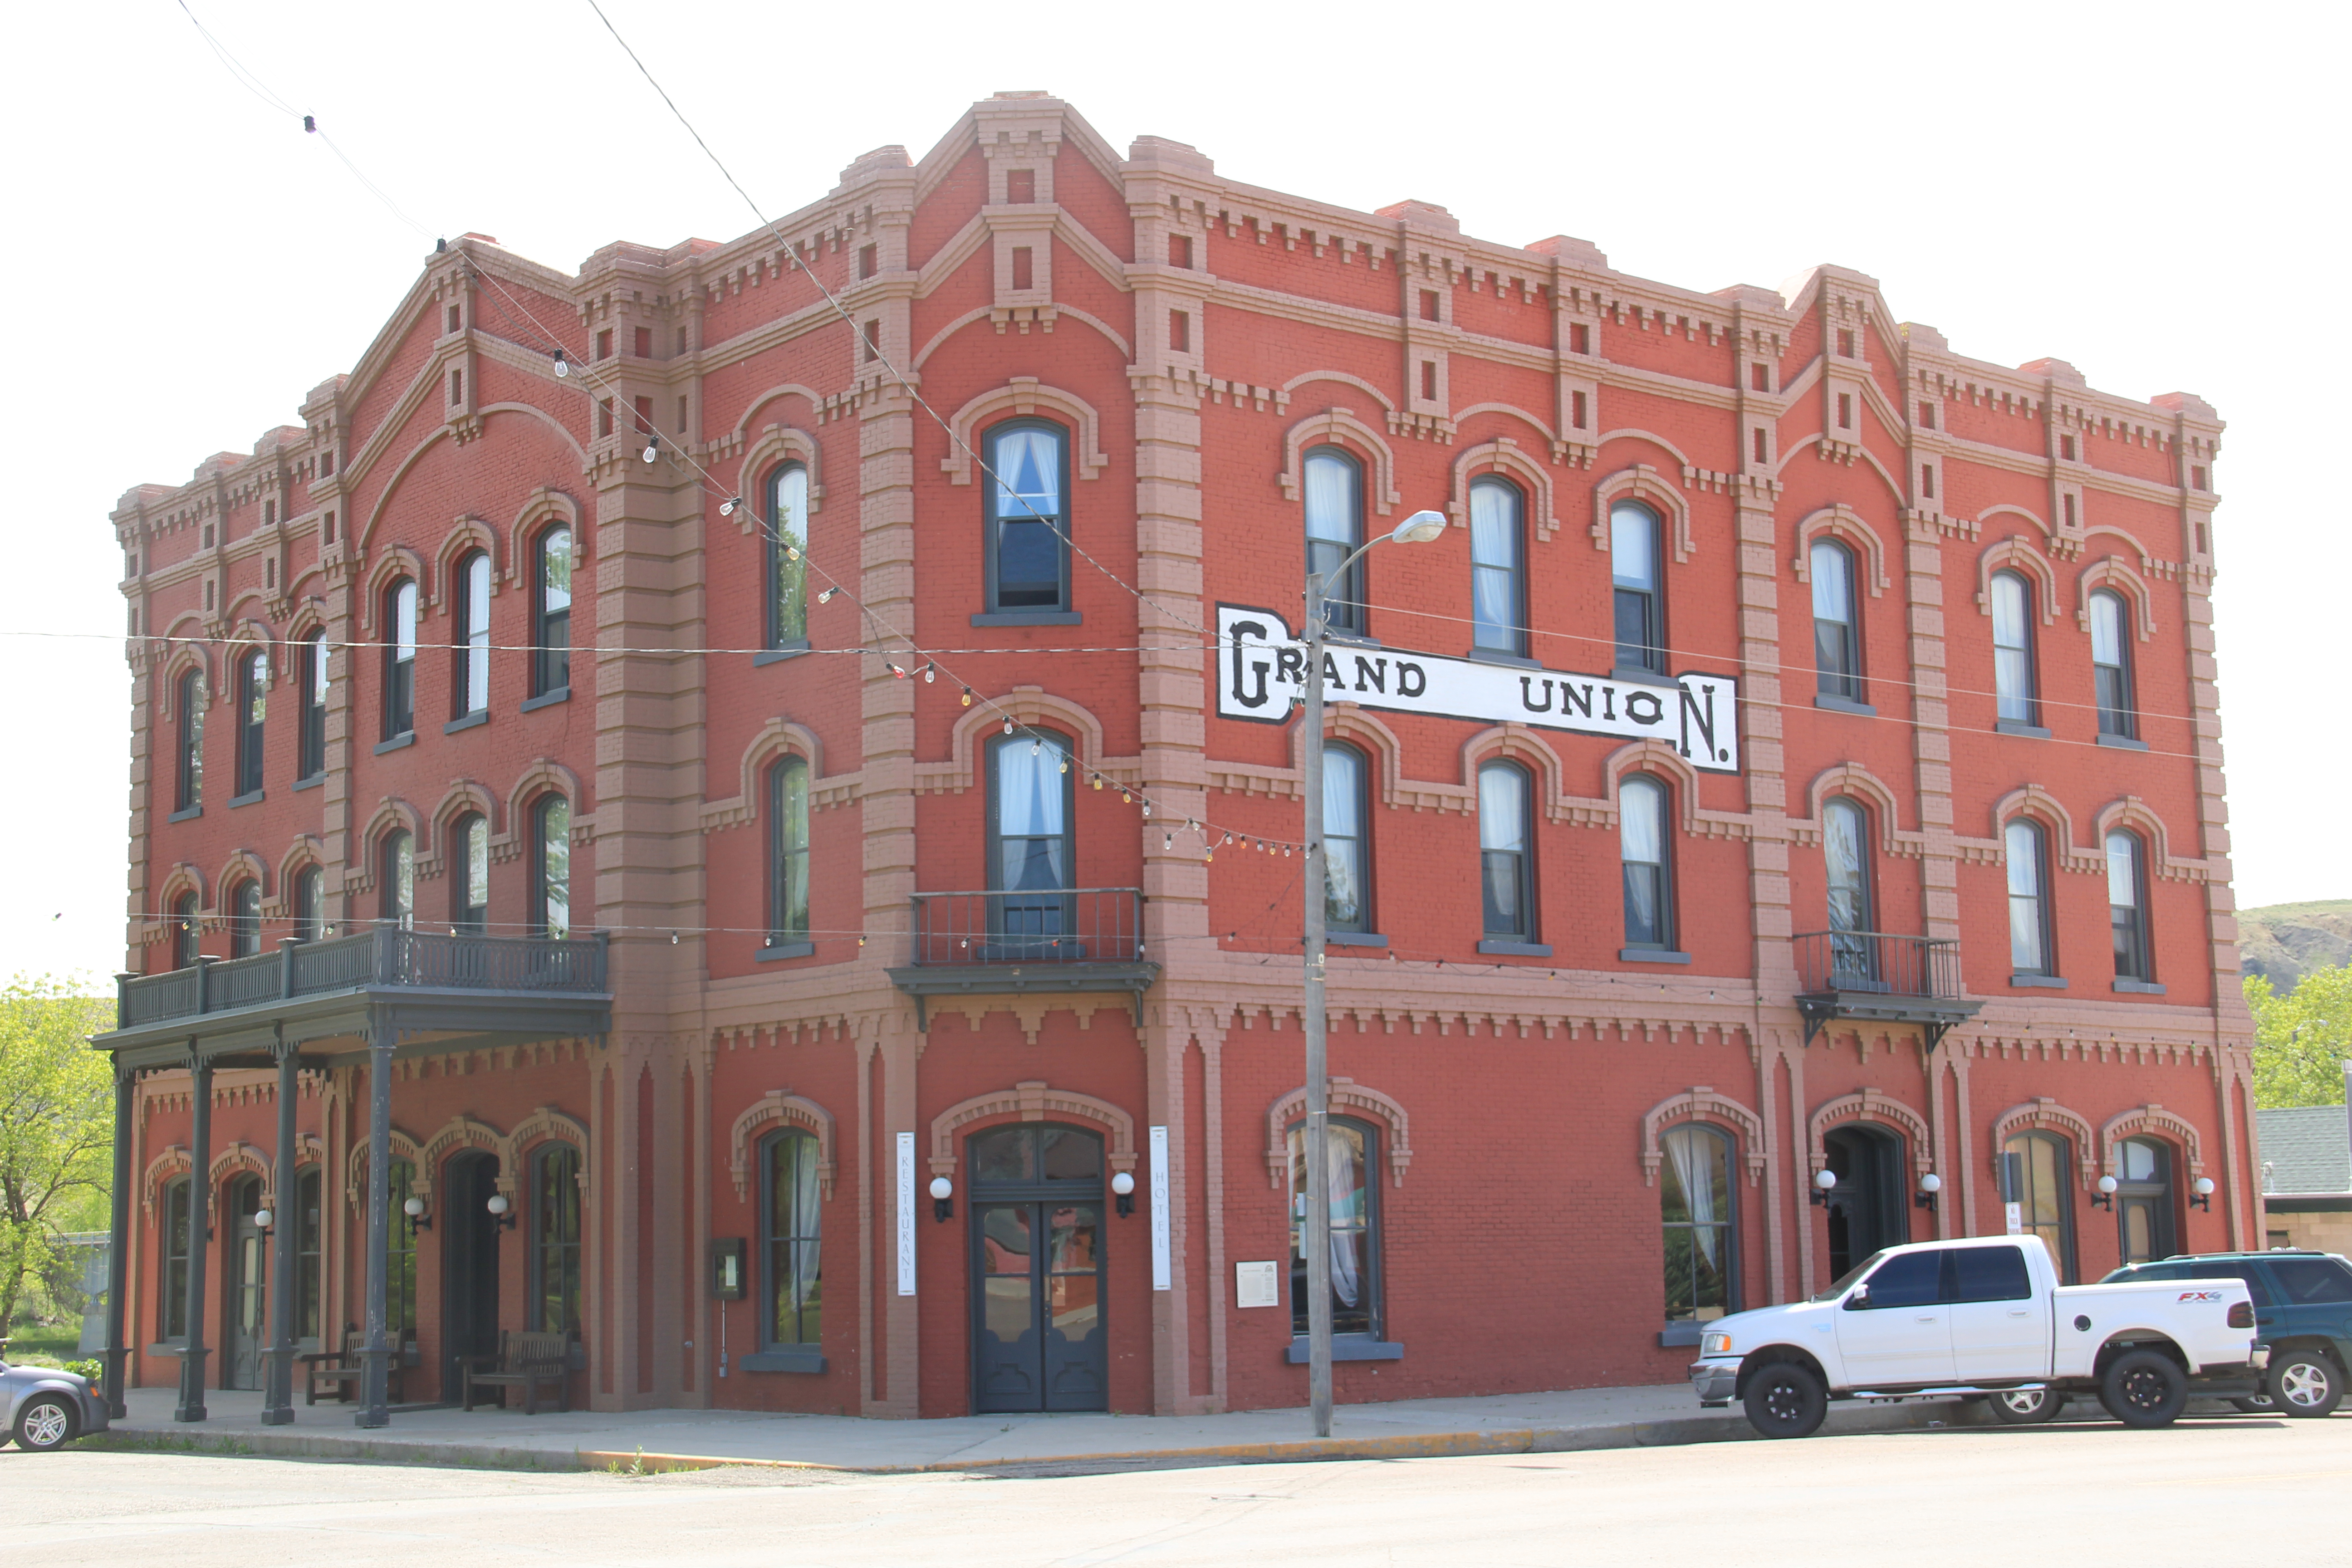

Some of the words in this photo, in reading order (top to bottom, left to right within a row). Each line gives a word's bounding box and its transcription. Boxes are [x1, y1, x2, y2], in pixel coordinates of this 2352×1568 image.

[1230, 621, 1426, 708] GRAND
[902, 1156, 910, 1279] RESTAURANT
[1154, 1171, 1166, 1248] HOTEL
[2178, 1291, 2222, 1300] FX4
